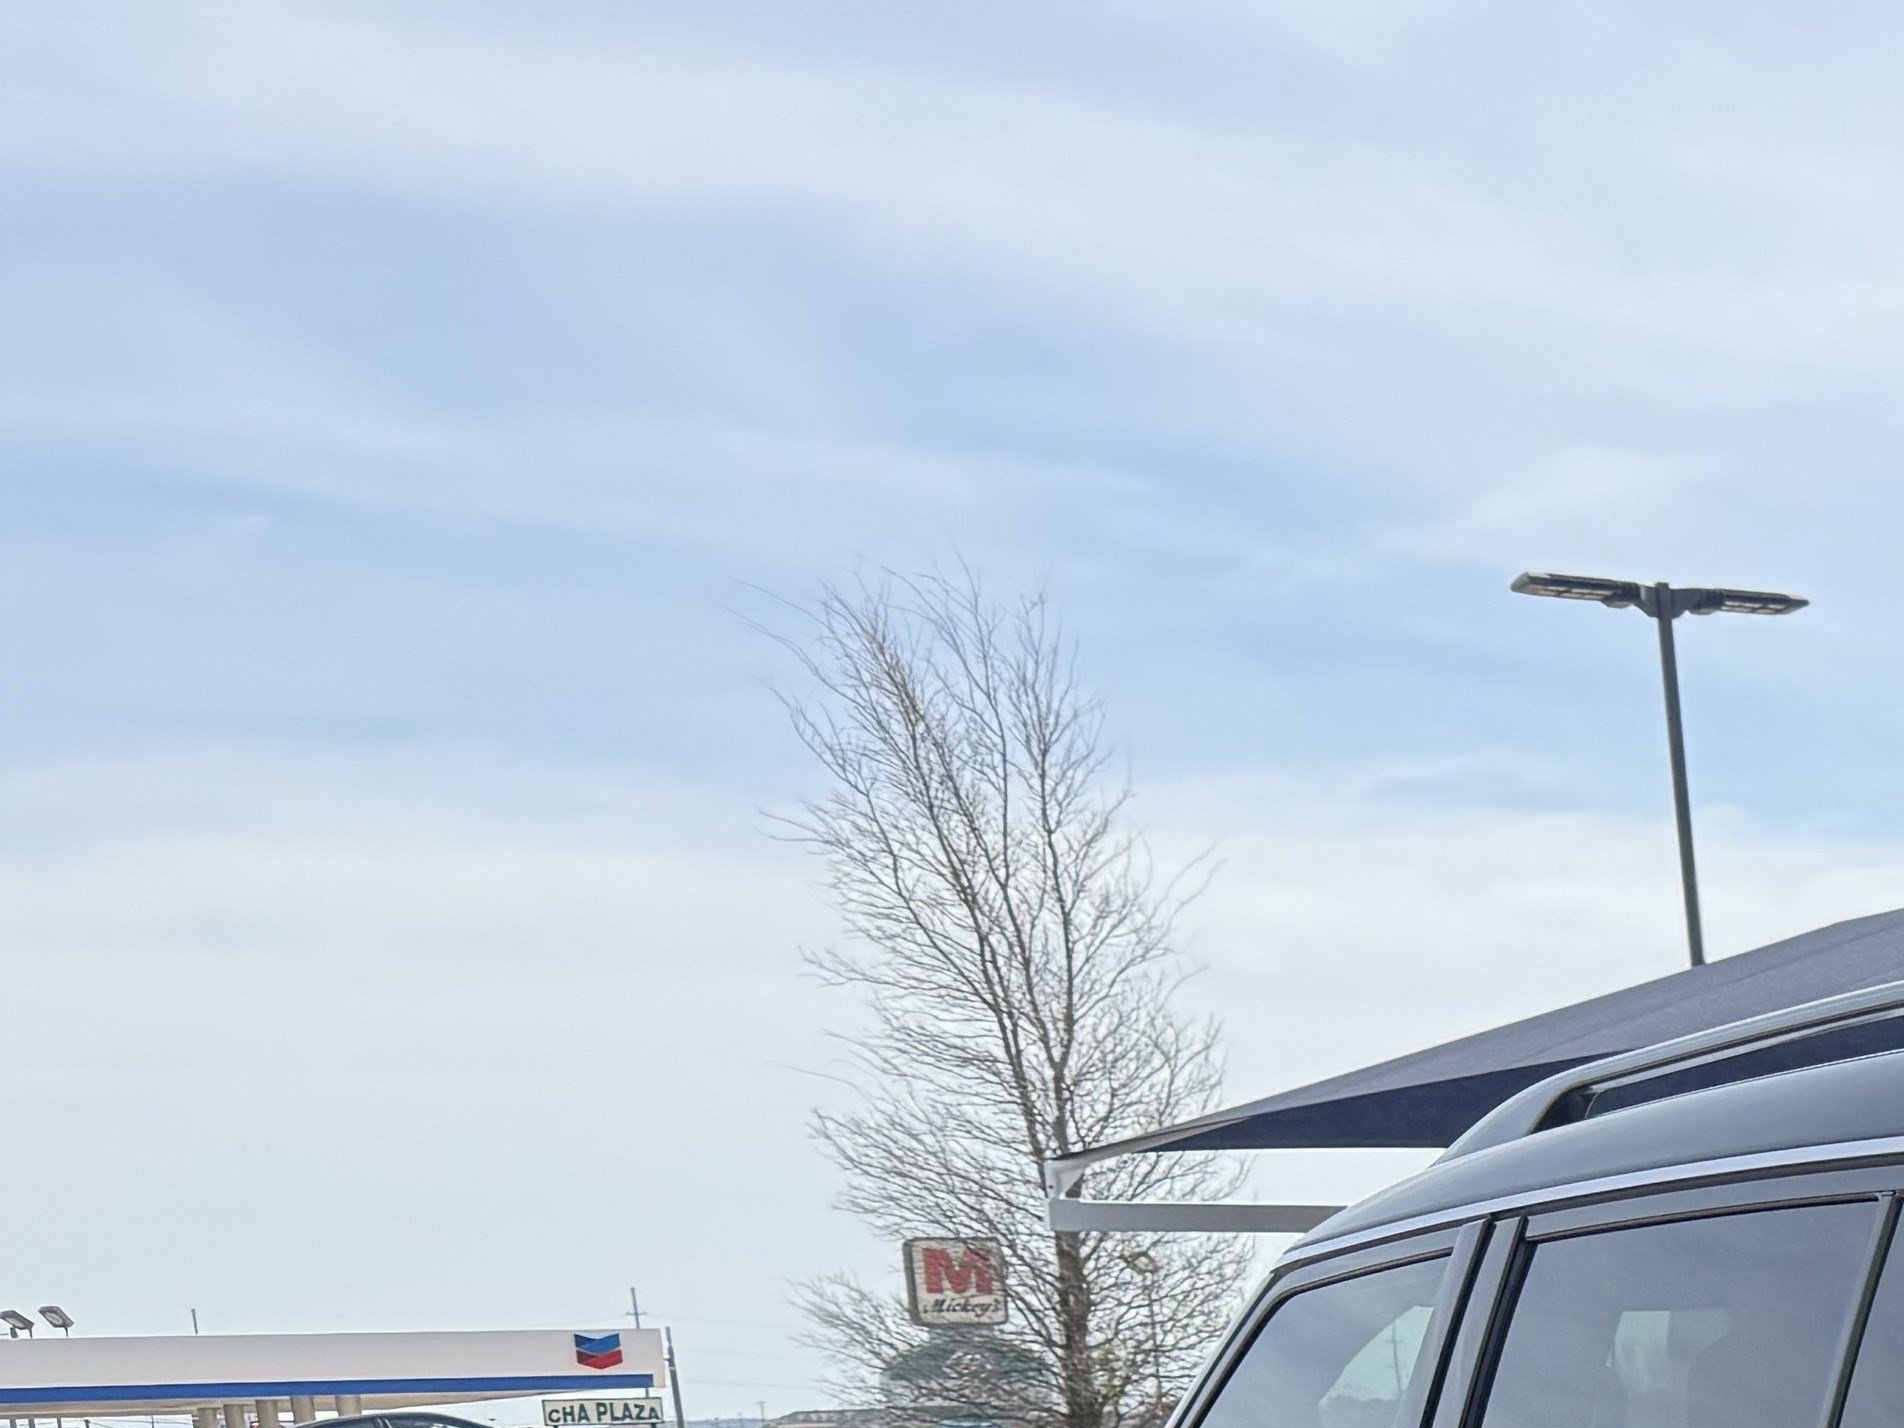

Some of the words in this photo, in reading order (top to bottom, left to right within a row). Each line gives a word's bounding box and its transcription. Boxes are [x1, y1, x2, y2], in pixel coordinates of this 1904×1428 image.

[923, 1248, 993, 1295] M
[548, 1403, 590, 1423] CHA
[596, 1402, 661, 1422] PLAZA
